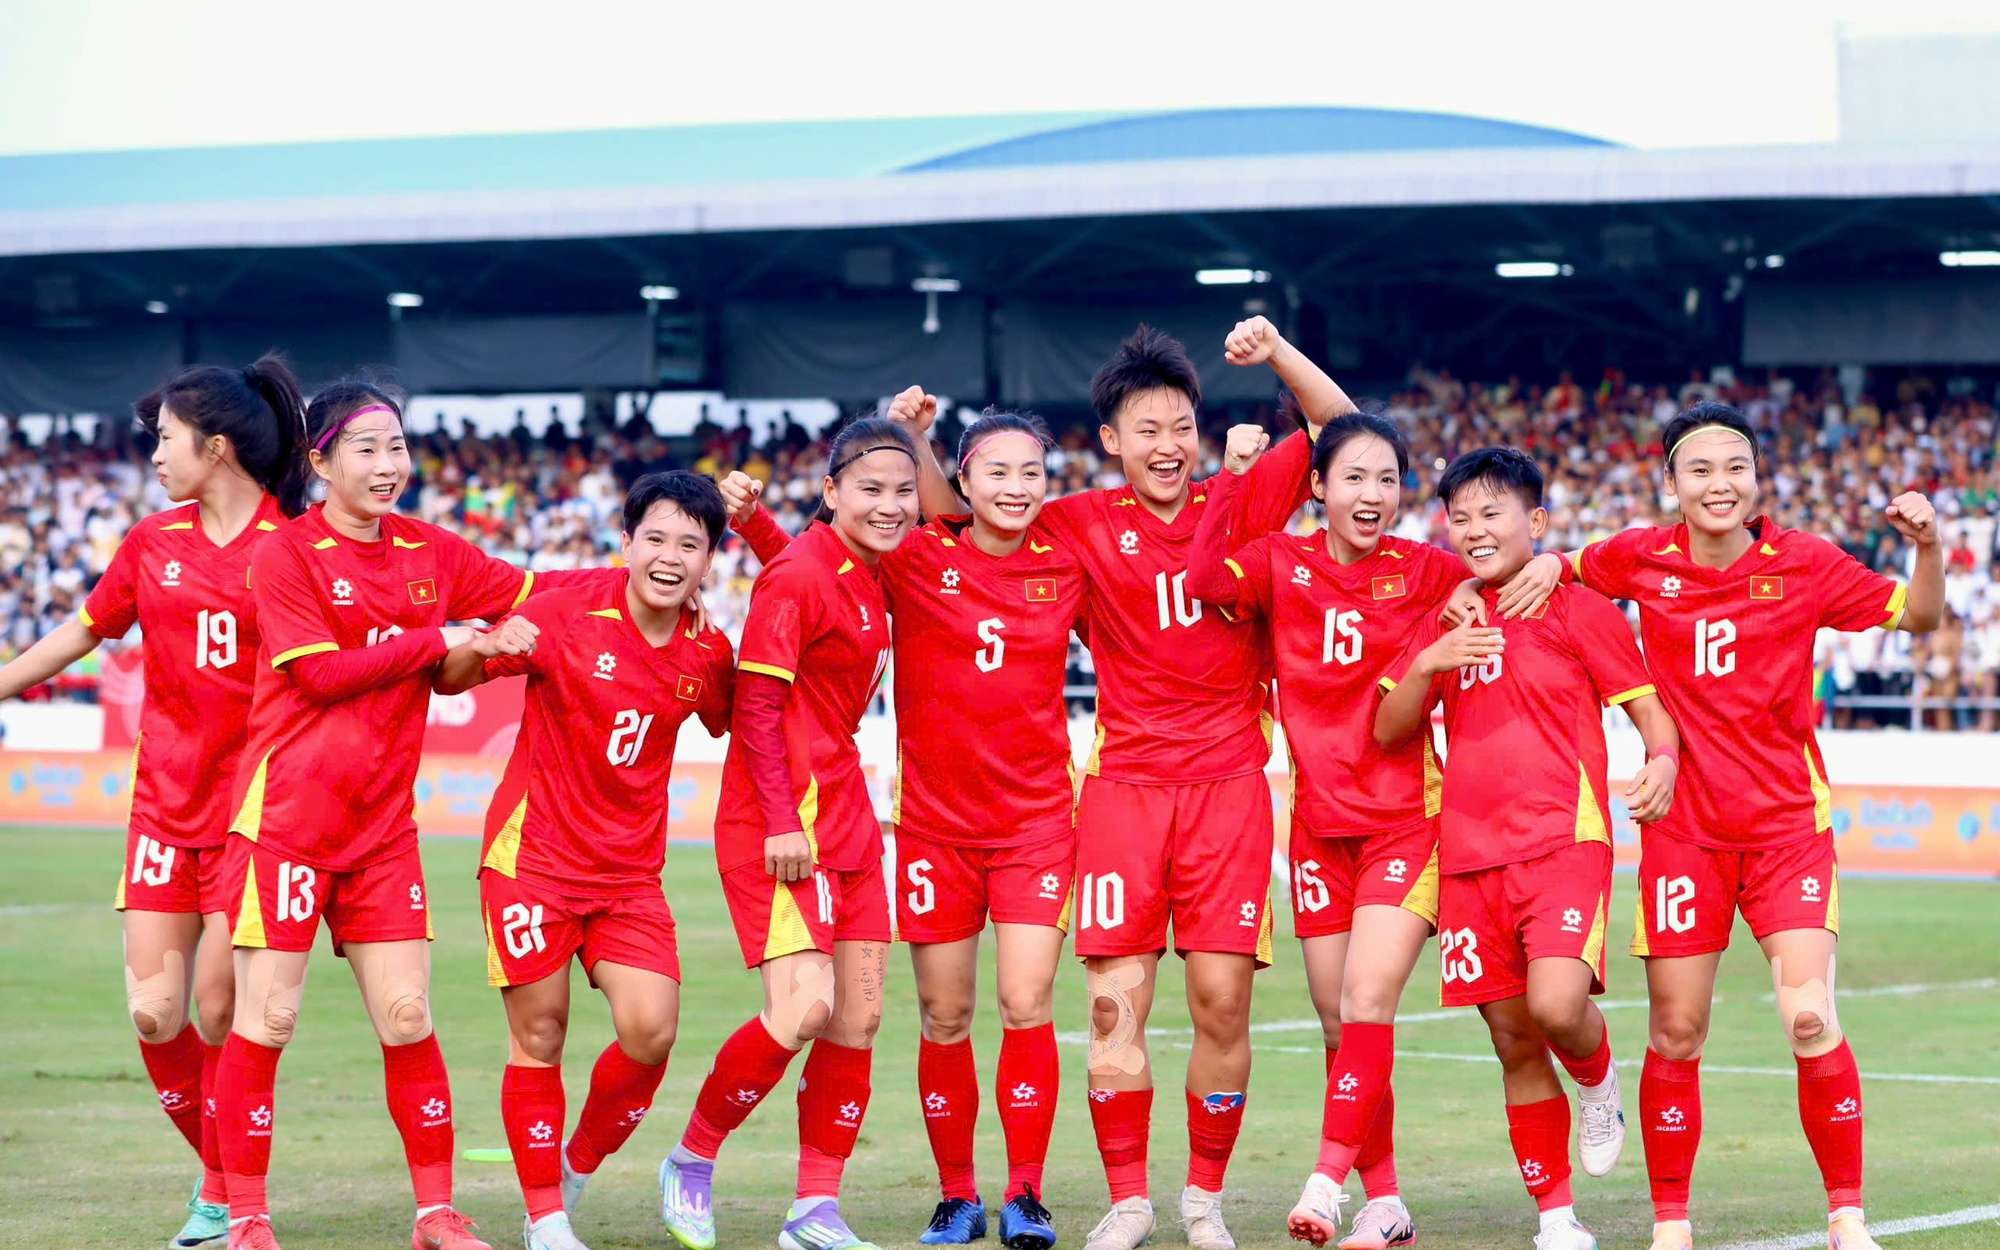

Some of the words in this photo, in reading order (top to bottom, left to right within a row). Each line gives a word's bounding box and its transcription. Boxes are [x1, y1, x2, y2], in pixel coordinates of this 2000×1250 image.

[195, 609, 237, 669] 19
[975, 617, 1006, 673] 5
[1322, 607, 1364, 666] 15
[1694, 617, 1737, 678] 12
[606, 708, 655, 767] 21
[131, 834, 175, 887] 19
[907, 858, 935, 916] 5
[1294, 859, 1331, 914] 15
[276, 861, 317, 923] 13
[1080, 871, 1125, 931] 10
[1656, 875, 1696, 934] 12
[502, 902, 547, 959] 21
[1440, 926, 1484, 985] 23
